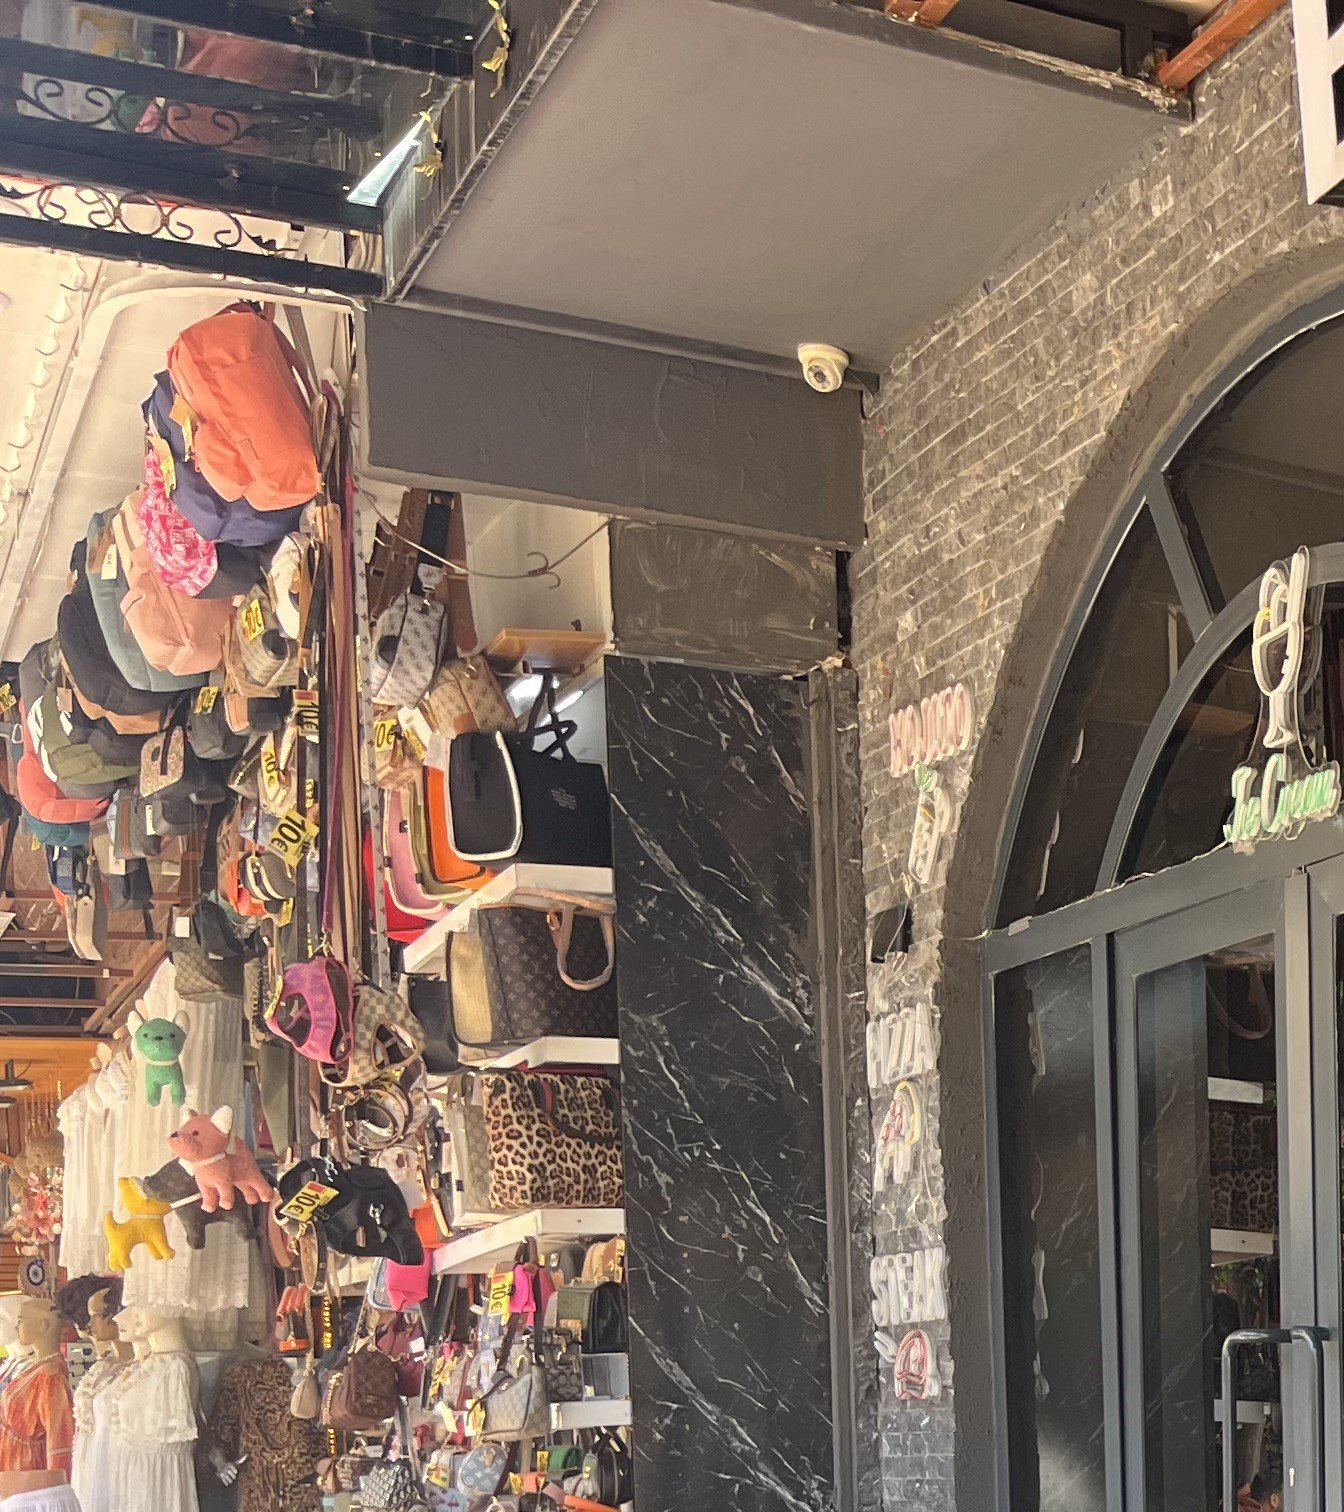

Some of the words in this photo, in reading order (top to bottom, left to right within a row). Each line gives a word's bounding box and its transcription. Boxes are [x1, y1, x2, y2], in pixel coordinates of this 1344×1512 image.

[270, 813, 307, 853] 10€
[866, 1002, 934, 1089] PIZZA
[287, 1191, 321, 1215] 10€
